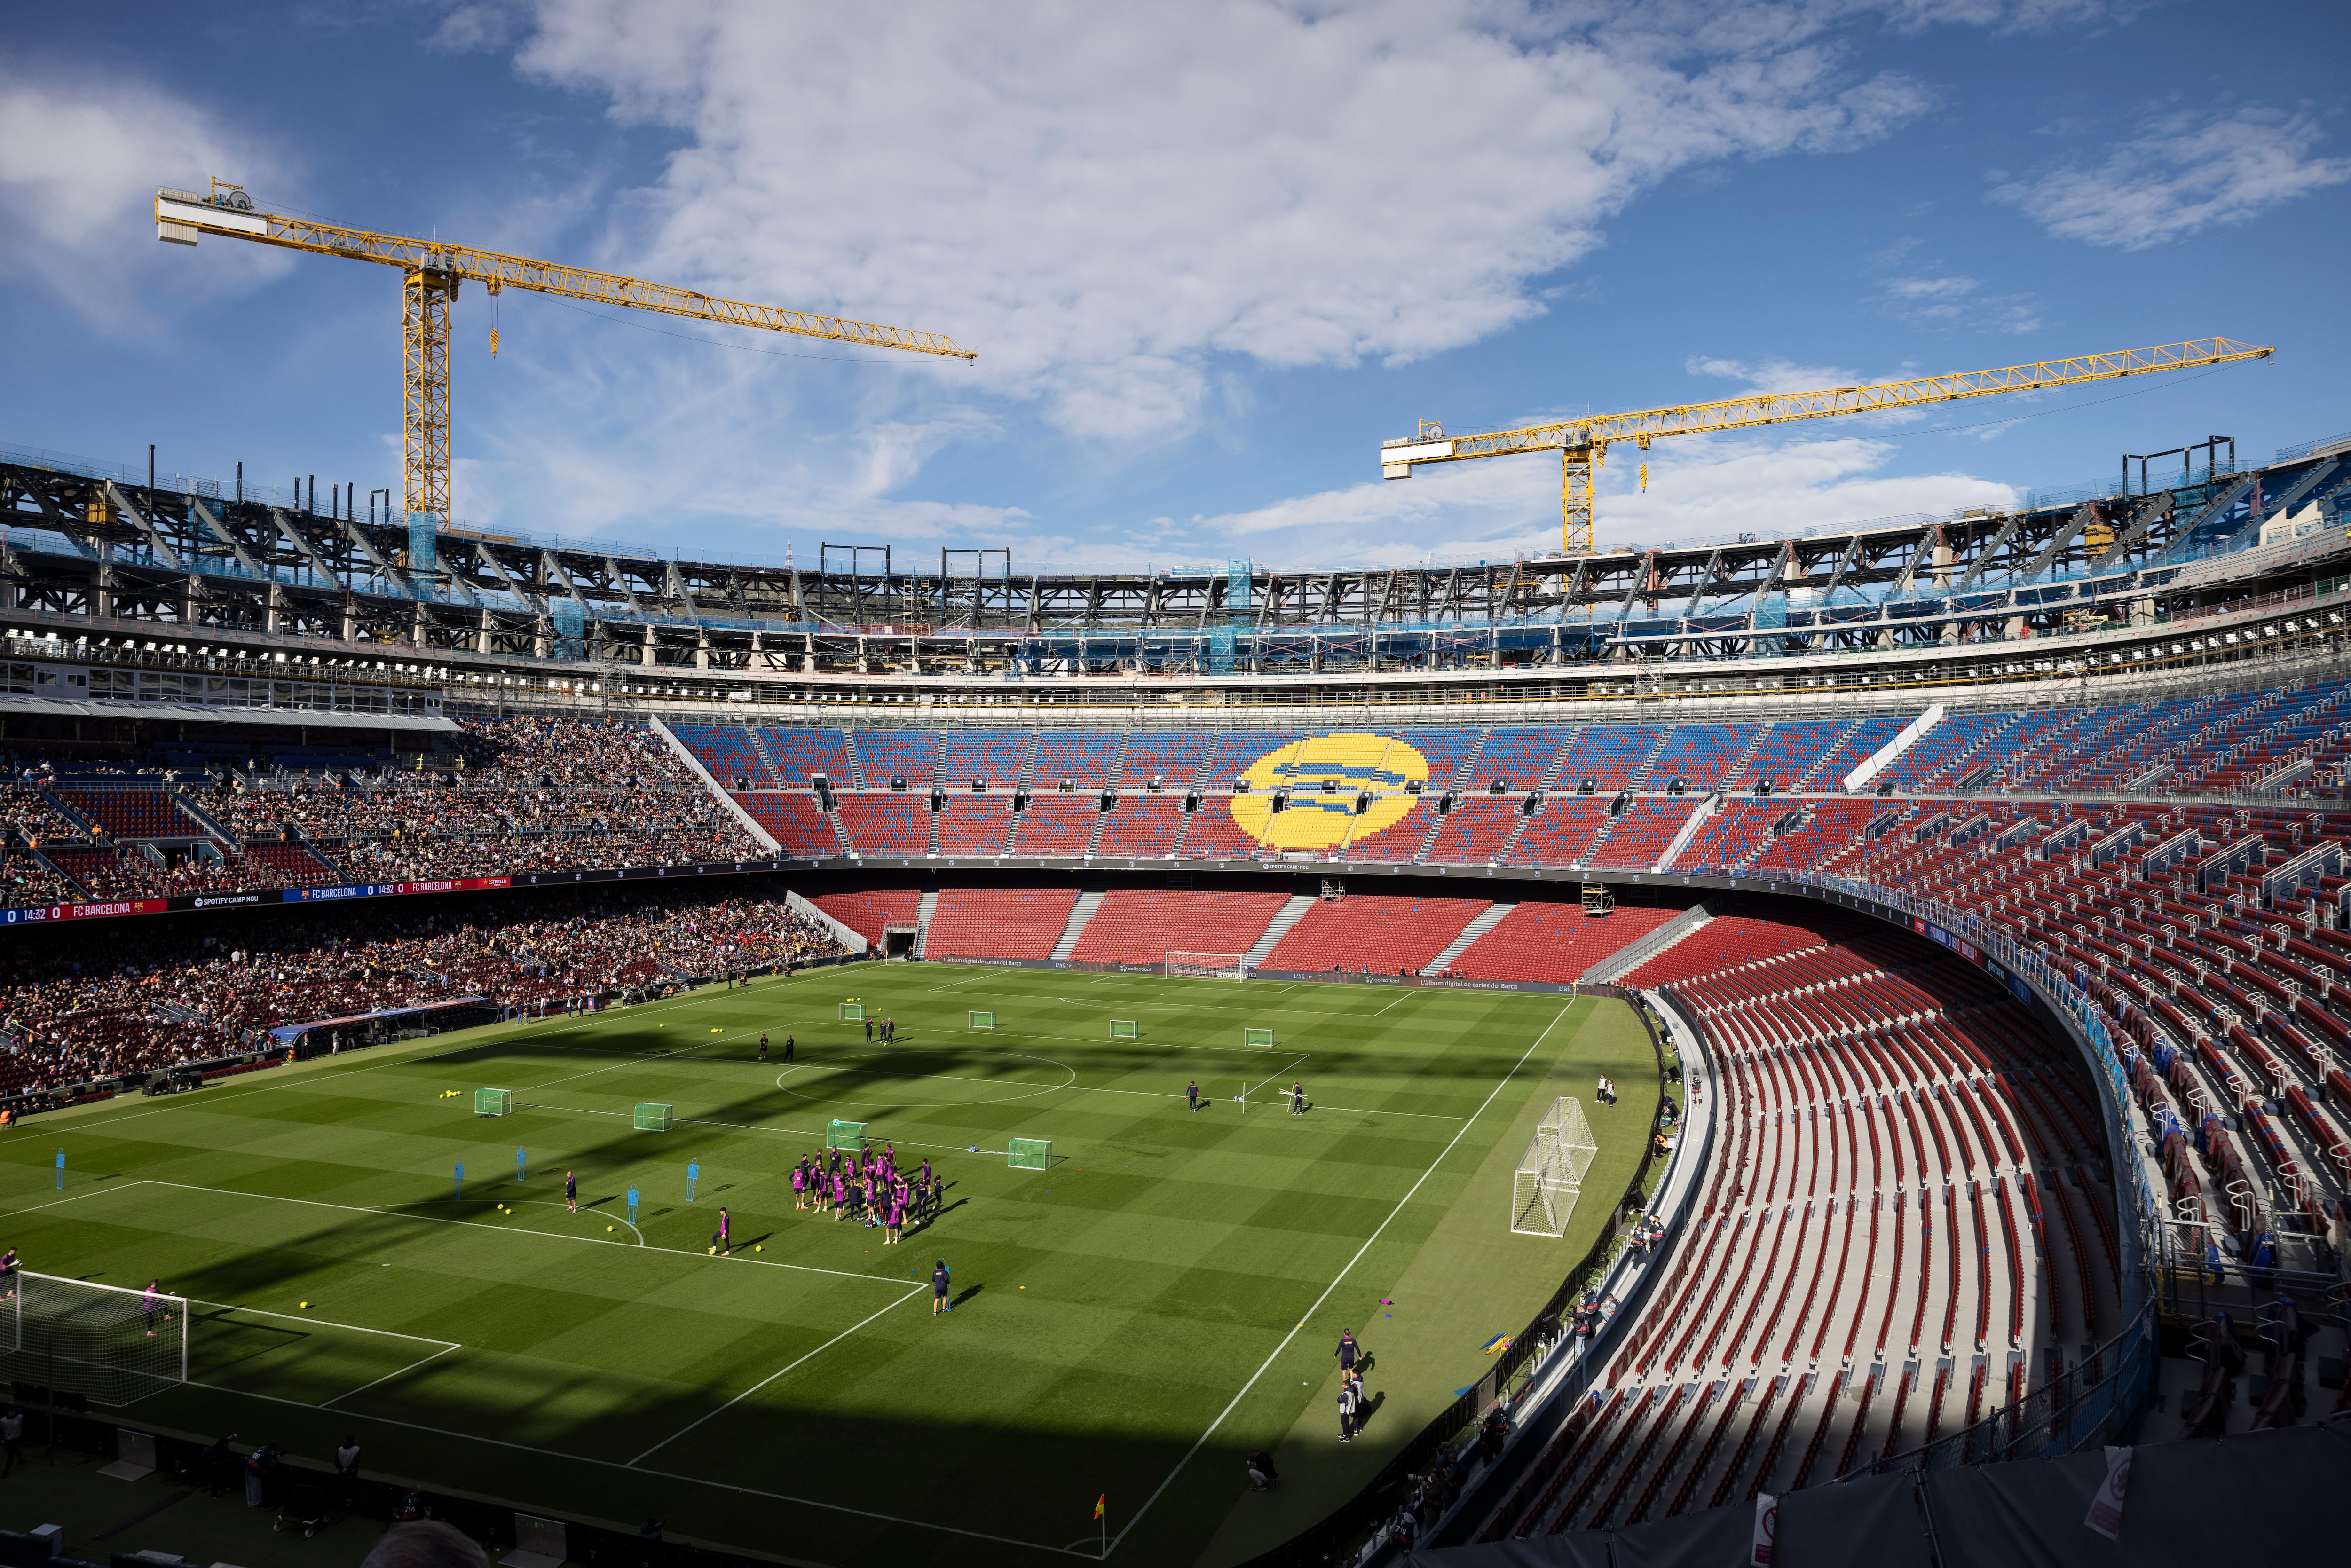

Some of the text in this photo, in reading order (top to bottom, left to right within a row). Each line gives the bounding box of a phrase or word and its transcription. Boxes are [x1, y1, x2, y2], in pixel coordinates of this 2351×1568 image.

[312, 881, 452, 899] FC BARCELONA 0 14:32 0 FC BARCELONA
[8, 903, 130, 922] 0 14:32 0 FC BARCELONA
[1396, 1525, 1406, 1535] 719
